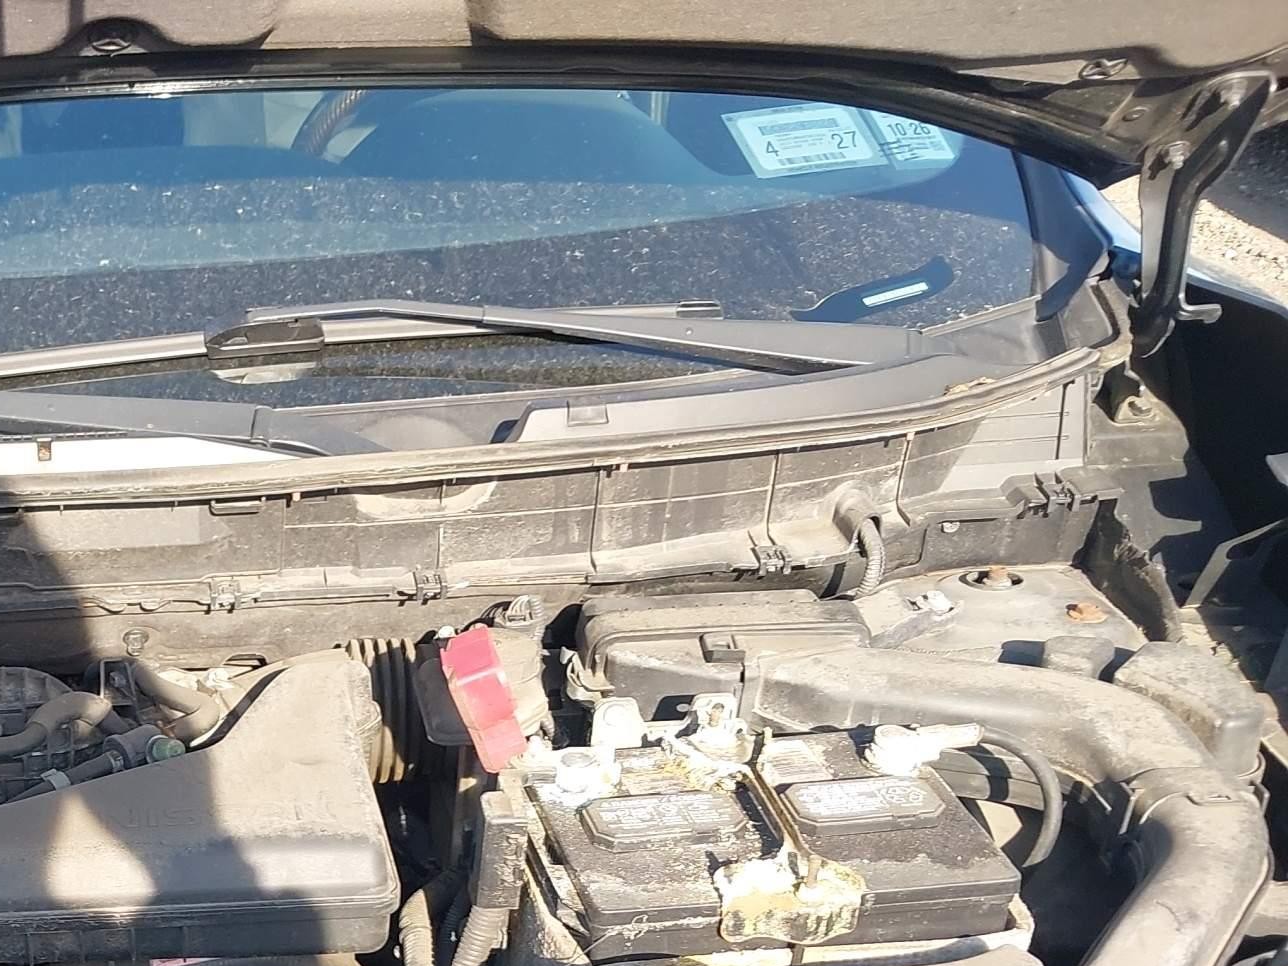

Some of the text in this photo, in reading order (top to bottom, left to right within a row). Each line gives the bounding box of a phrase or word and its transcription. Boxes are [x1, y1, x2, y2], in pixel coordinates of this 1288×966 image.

[886, 122, 931, 137] 10 26
[831, 130, 857, 149] 27
[765, 140, 780, 157] 4
